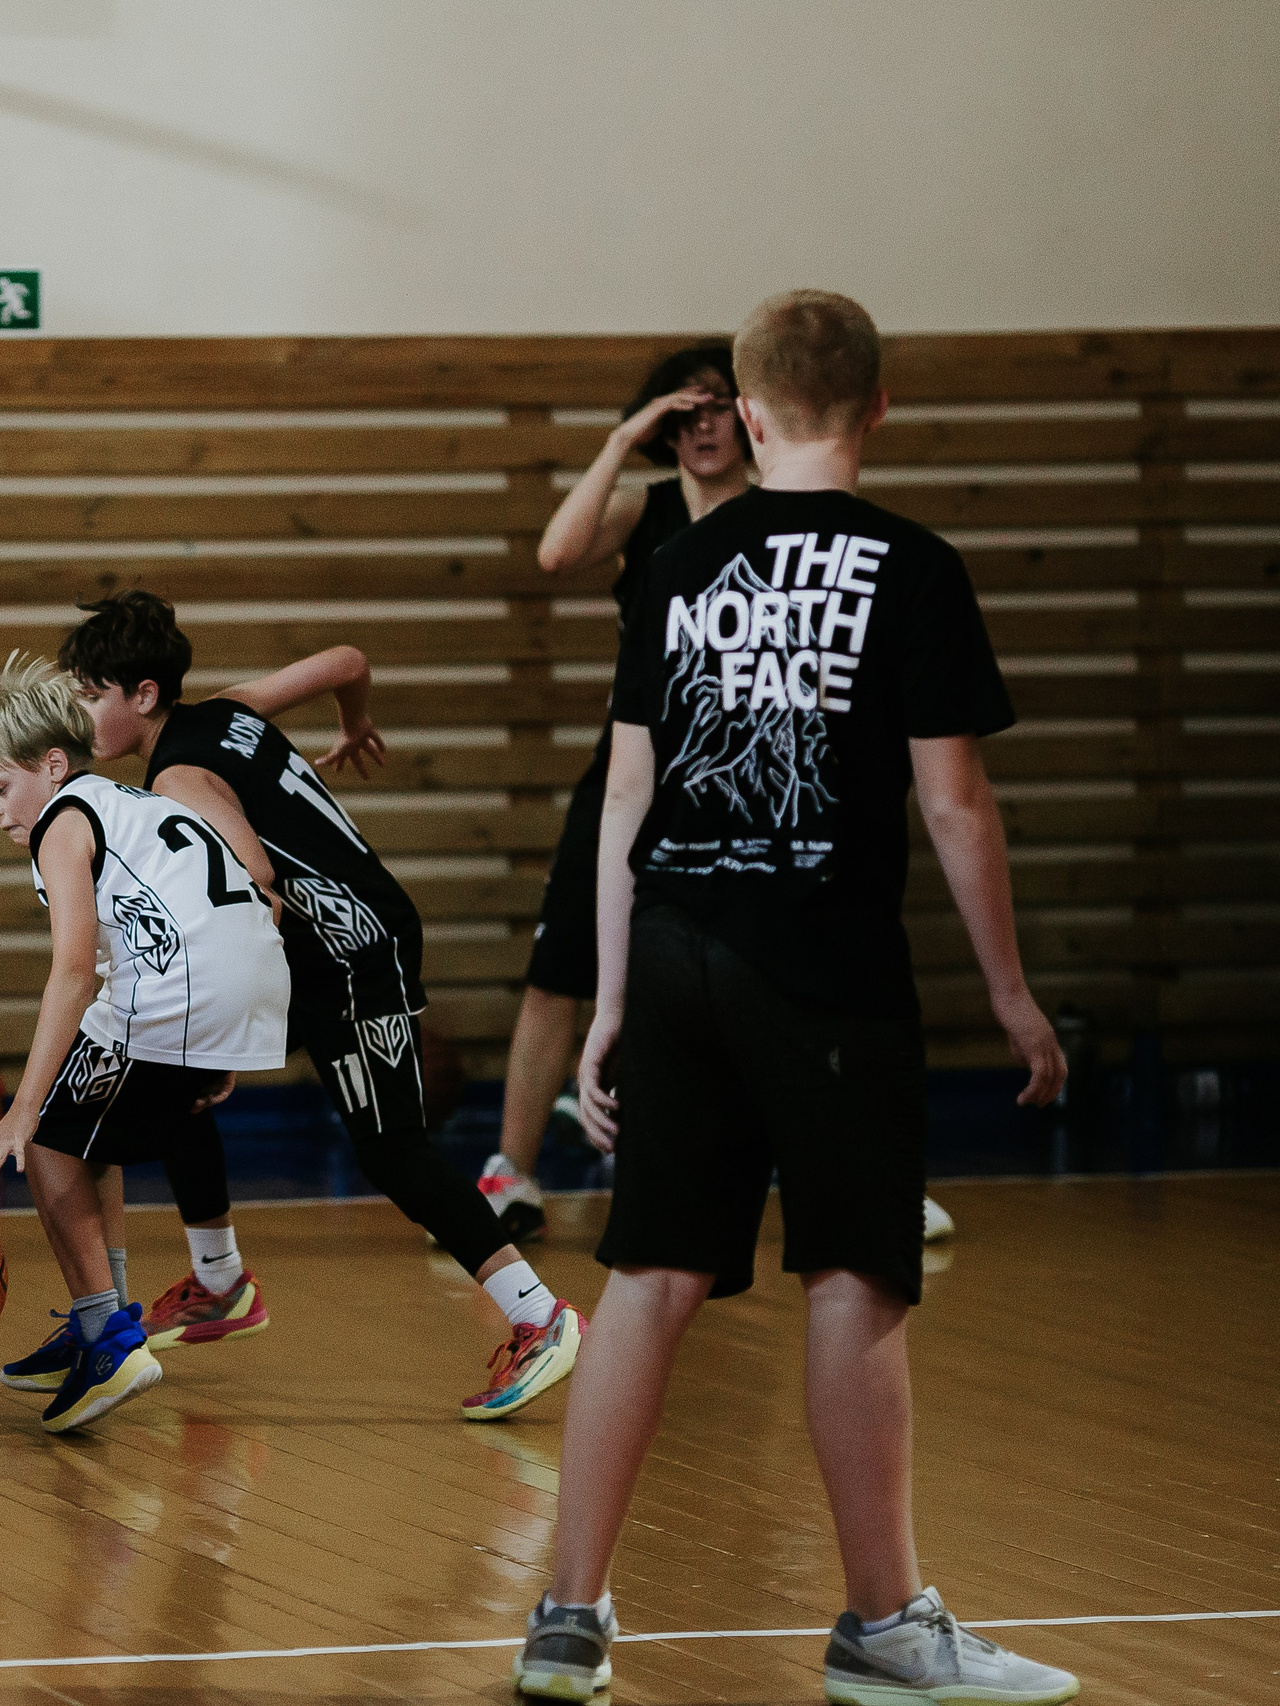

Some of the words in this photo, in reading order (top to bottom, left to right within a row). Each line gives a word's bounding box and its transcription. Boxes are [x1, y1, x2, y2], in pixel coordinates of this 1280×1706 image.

[765, 532, 890, 594] THE
[666, 590, 872, 654] NORTH
[721, 650, 860, 713] FACE
[279, 751, 368, 854] 11
[157, 815, 273, 909] 2
[331, 1053, 368, 1113] 11
